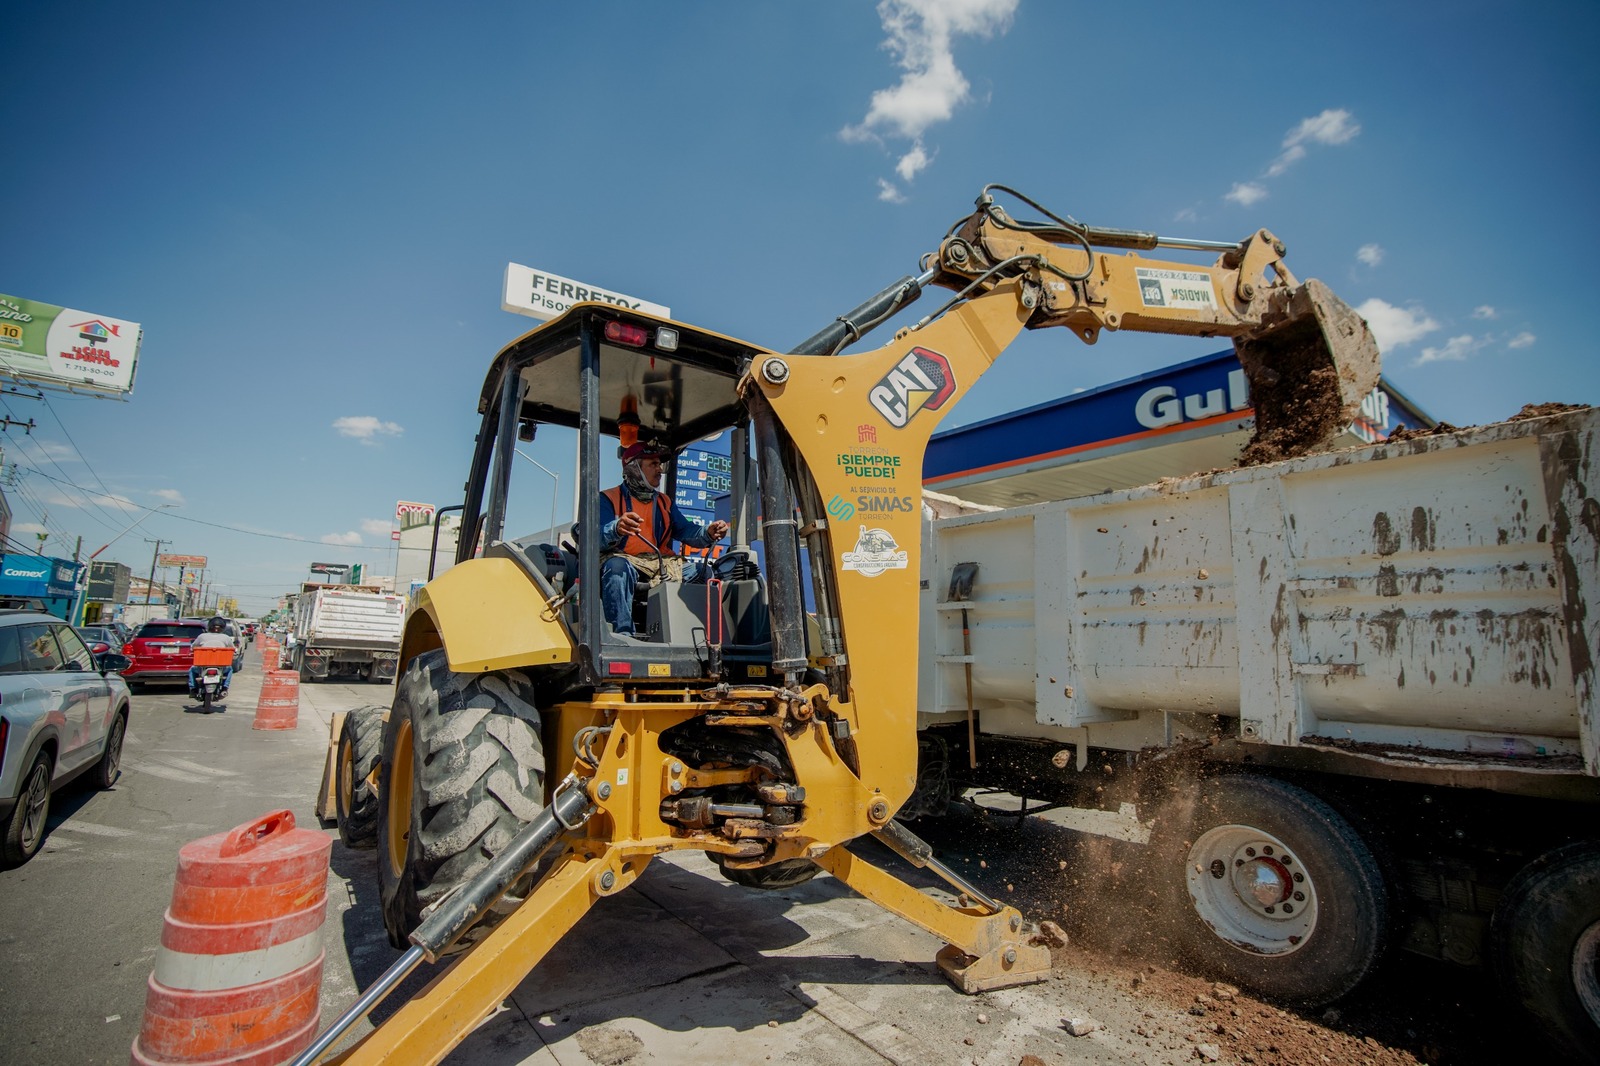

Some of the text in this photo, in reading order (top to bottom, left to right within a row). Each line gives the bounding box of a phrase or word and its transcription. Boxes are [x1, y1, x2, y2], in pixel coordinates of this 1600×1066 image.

[532, 274, 641, 309] FERRETO
[1171, 288, 1210, 302] MADISA
[3, 326, 19, 338] 10
[82, 346, 111, 359] CASA
[76, 353, 120, 367] PINTOR
[870, 352, 938, 427] CAT
[1135, 369, 1249, 430] Gul
[1361, 386, 1389, 429] ulf
[677, 459, 700, 467] egular
[837, 454, 901, 467] ¡SIEMPRE
[845, 466, 895, 479] PUEDE!
[676, 480, 702, 488] remium
[859, 486, 887, 494] SERVICIO
[4, 568, 47, 578] Comex
